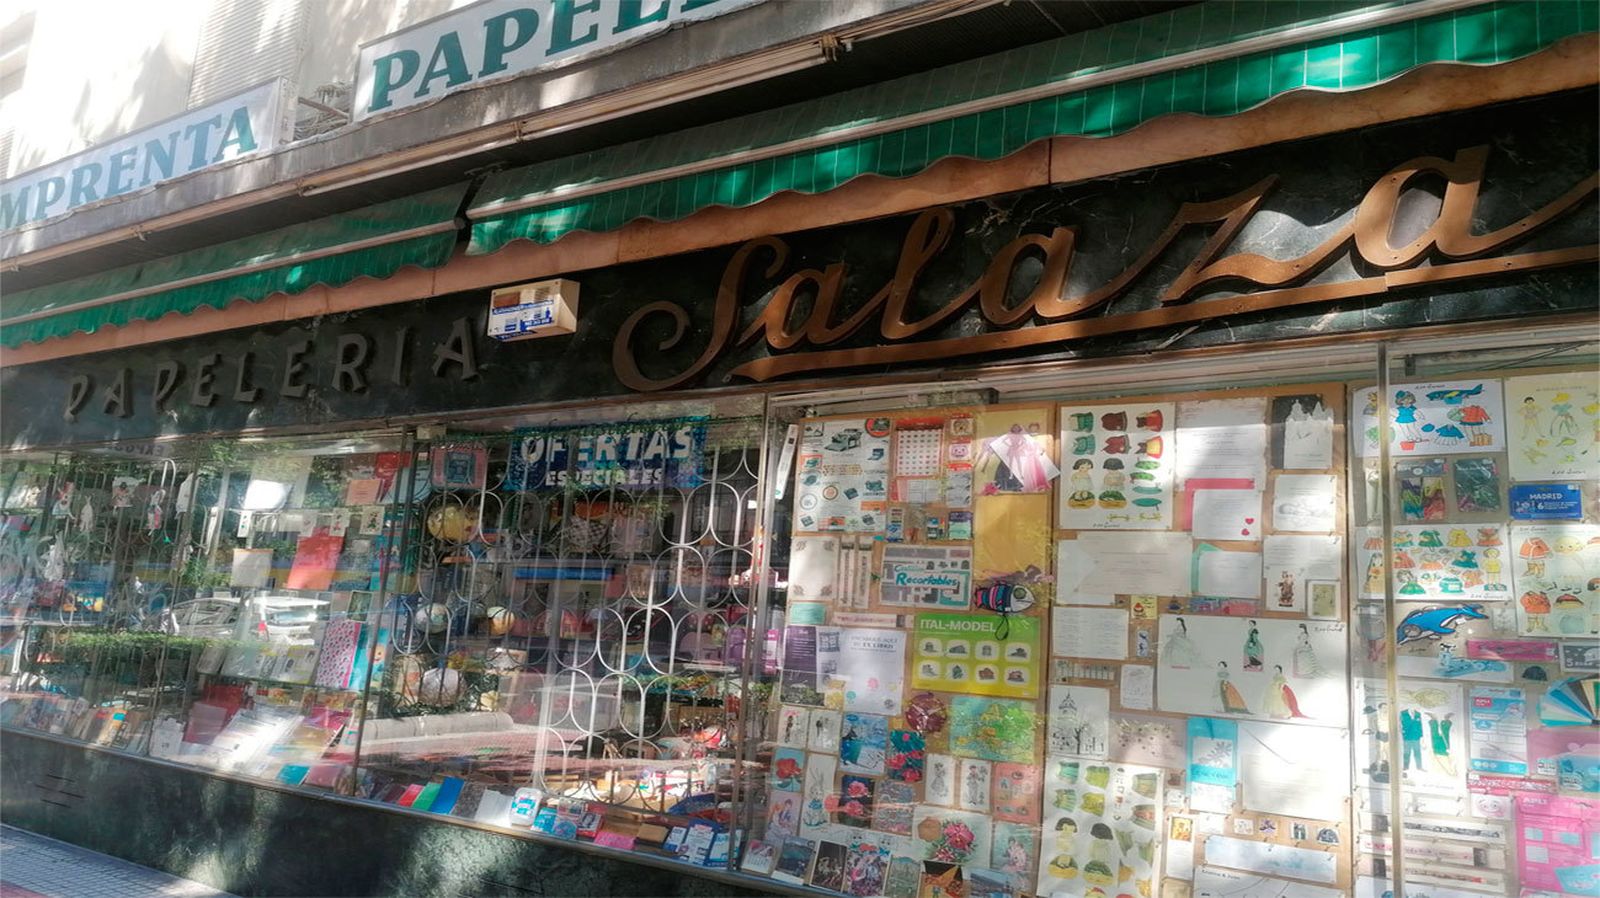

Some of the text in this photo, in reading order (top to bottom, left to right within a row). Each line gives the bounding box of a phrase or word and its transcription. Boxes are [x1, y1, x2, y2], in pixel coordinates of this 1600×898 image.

[367, 0, 720, 113] PAPEL
[63, 316, 482, 423] PAPELERIA
[521, 424, 693, 464] OFERTAS
[895, 572, 958, 586] Recortables
[920, 618, 996, 633] ITAL-MODEL
